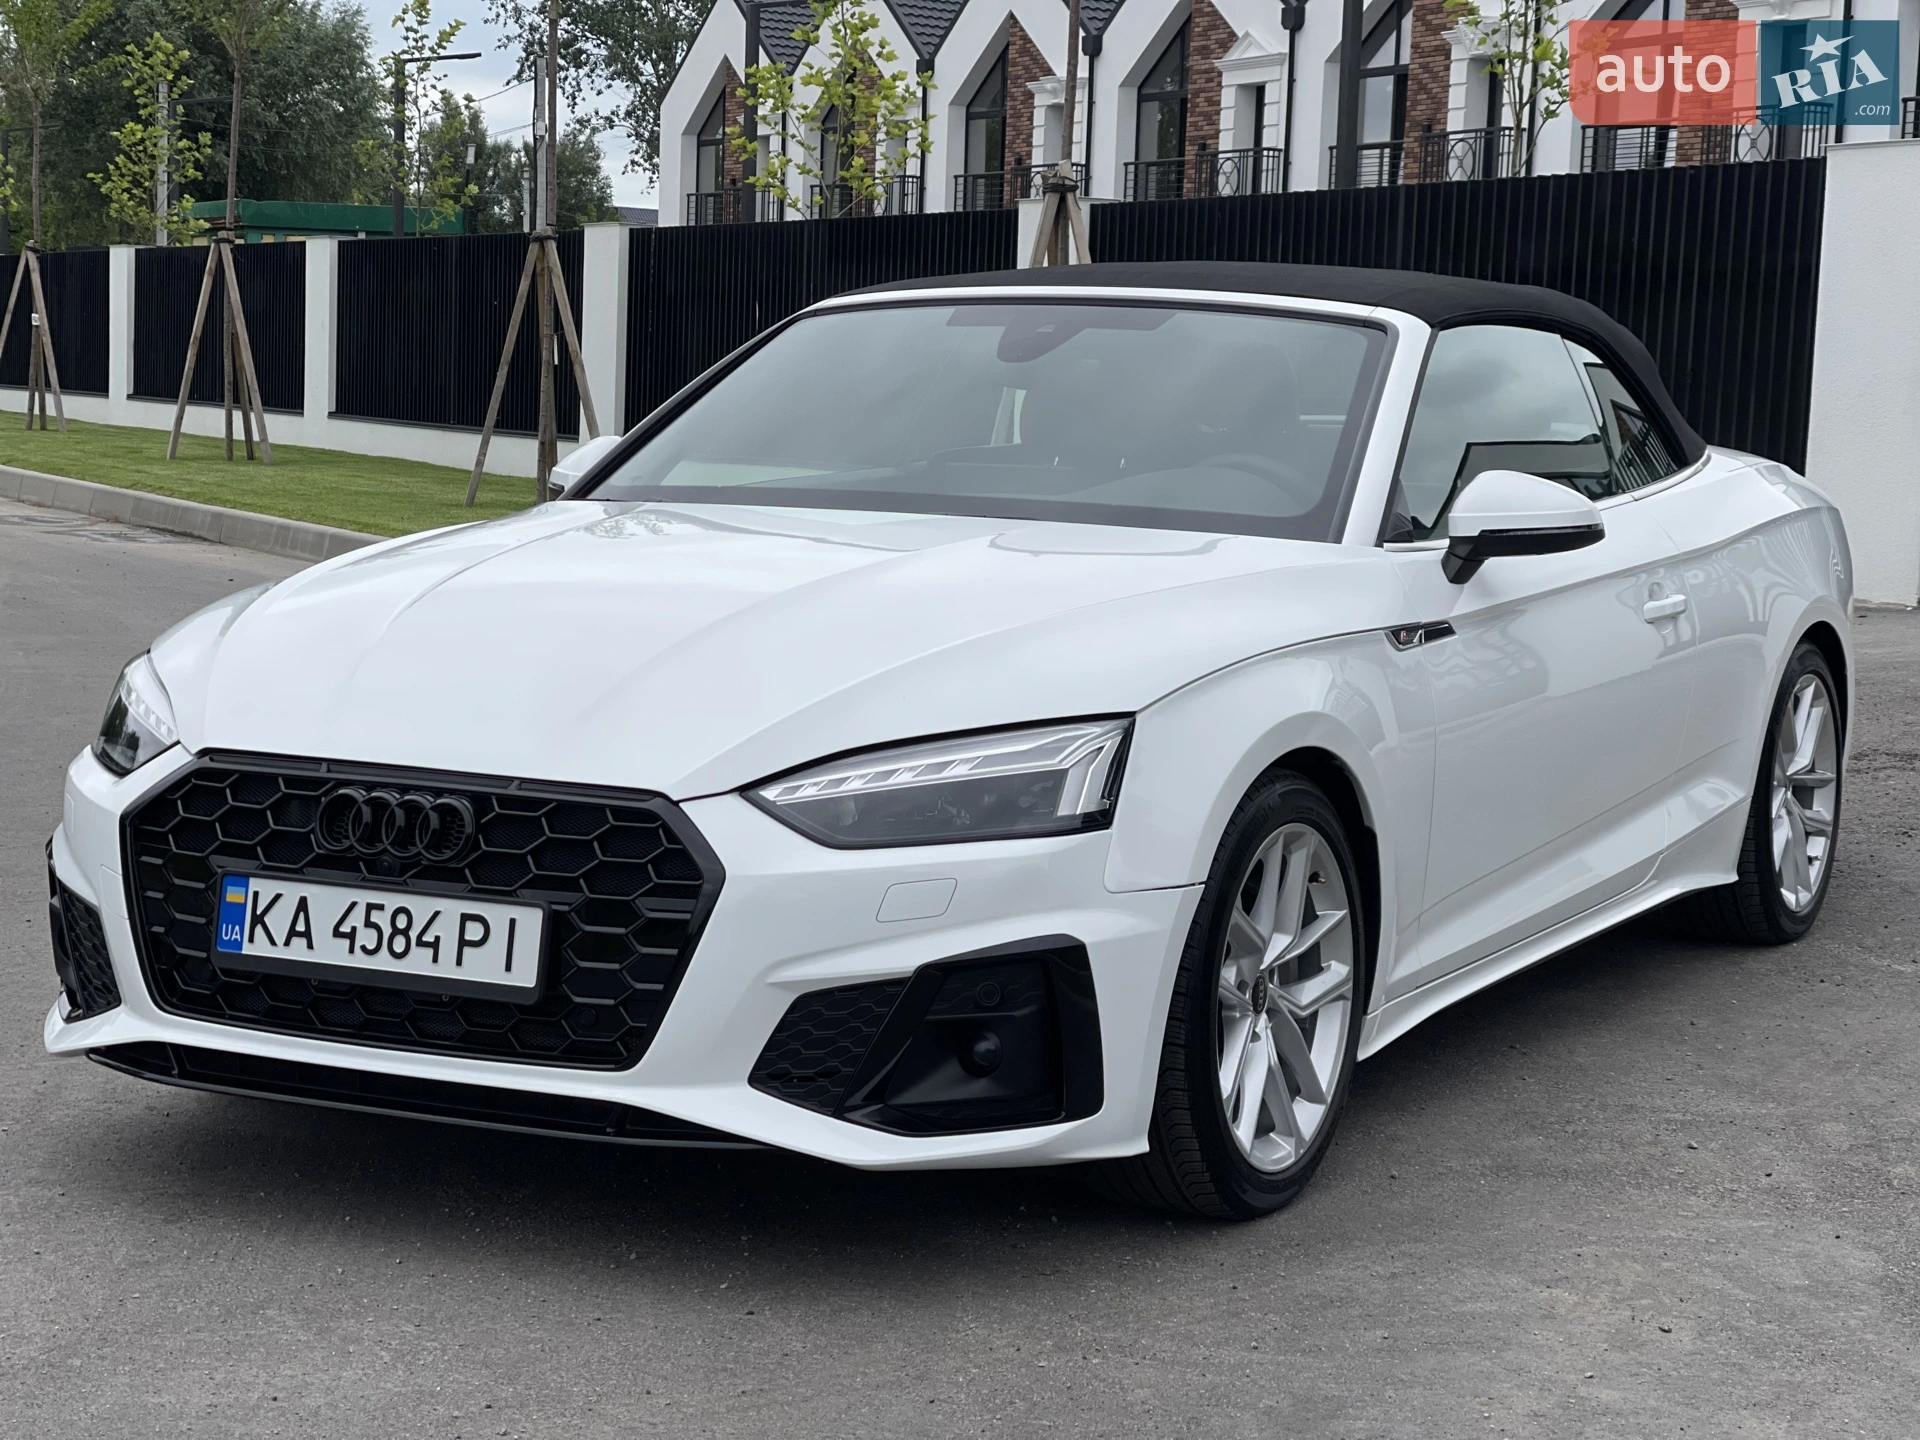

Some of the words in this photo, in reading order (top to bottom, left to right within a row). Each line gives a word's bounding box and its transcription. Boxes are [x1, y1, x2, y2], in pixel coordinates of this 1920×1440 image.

[221, 923, 241, 942] UA
[248, 890, 314, 950] KA
[332, 900, 441, 964] 4584
[456, 912, 516, 972] PI
